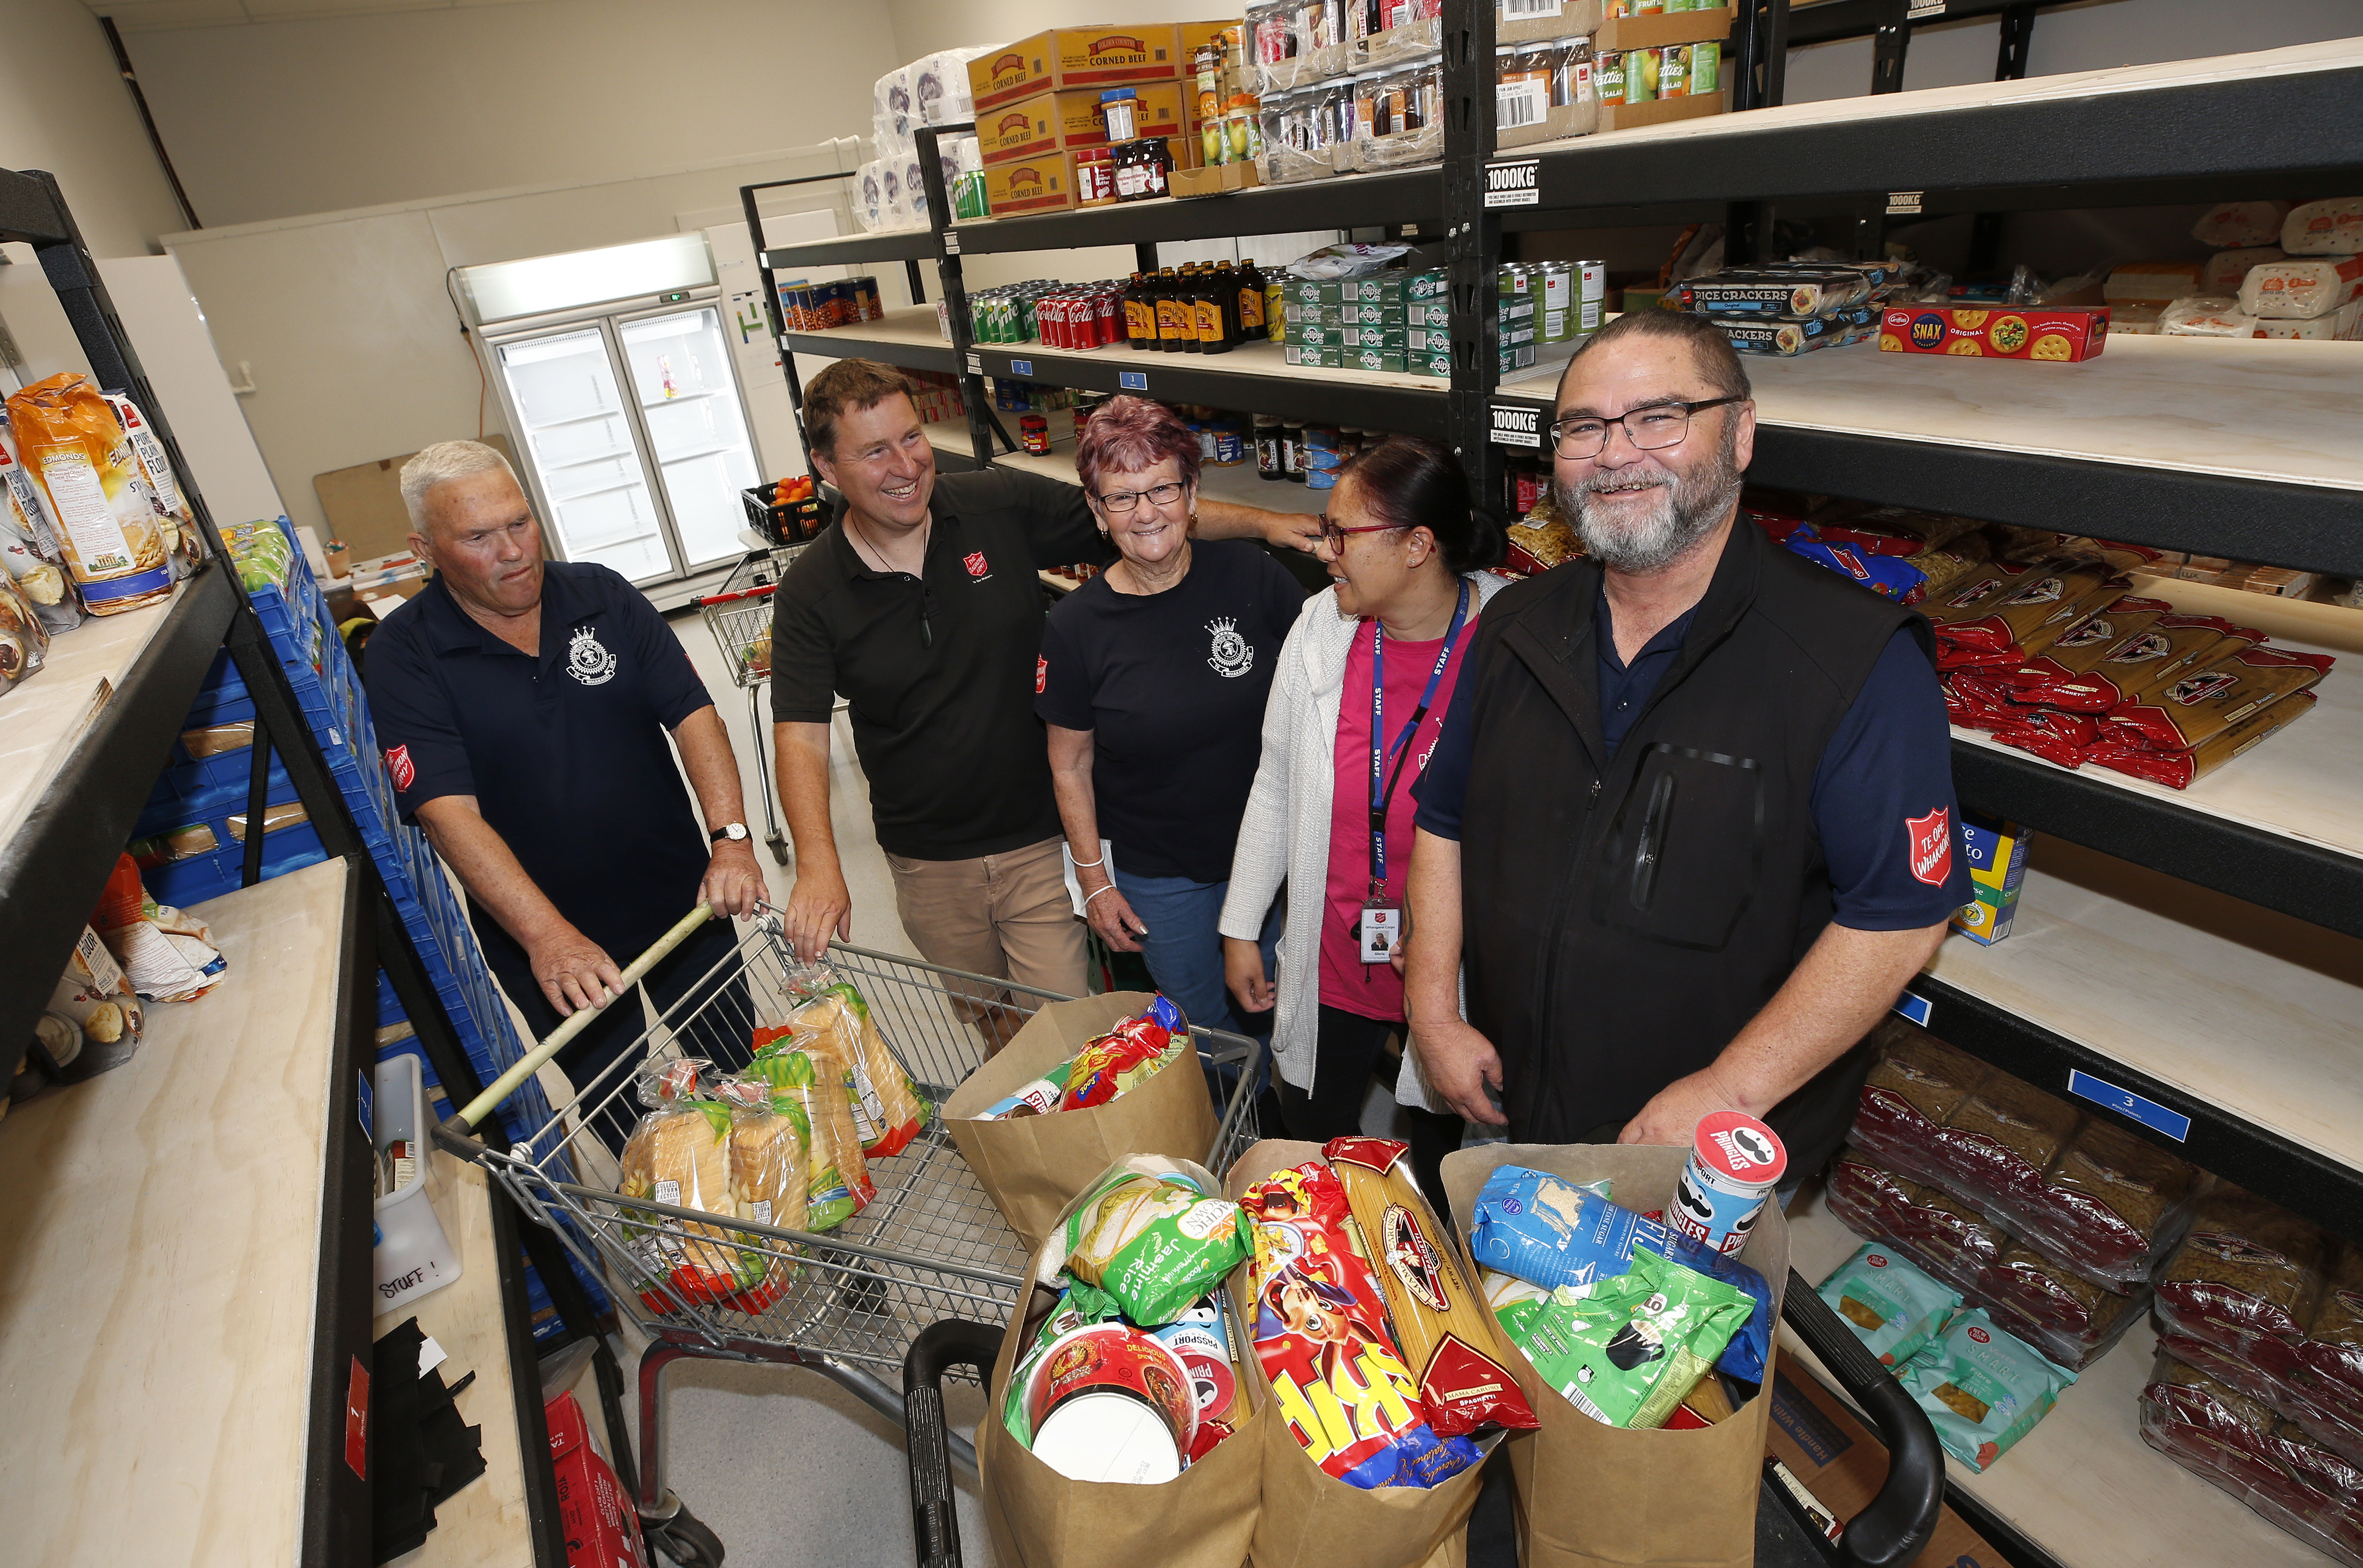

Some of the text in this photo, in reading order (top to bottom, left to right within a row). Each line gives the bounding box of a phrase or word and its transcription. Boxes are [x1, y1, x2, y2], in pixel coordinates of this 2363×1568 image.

[1638, 0, 1656, 8] FRUIT
[1090, 56, 1125, 66] CORNED
[1128, 53, 1147, 63] BEEF
[993, 71, 1026, 90] CORNED BEEF
[1661, 81, 1682, 90] SALAD
[1605, 89, 1623, 98] SALAD
[1000, 131, 1031, 147] CORNED BEEF
[1011, 187, 1043, 199] CORNED BEEF
[1299, 286, 1320, 299] eclipse
[1359, 284, 1382, 297] eclipse
[1409, 280, 1435, 296] eclipse
[1695, 291, 1788, 301] RICE CRACKERS
[1069, 300, 1094, 323] Cola
[1301, 308, 1322, 320] eclipse
[1359, 308, 1382, 322] eclipse
[1426, 309, 1449, 323] eclipse
[1889, 315, 1908, 324] Griffin's
[1302, 329, 1324, 343] eclipse
[1360, 329, 1384, 343] eclipse
[1912, 322, 1943, 340] SNAX
[1950, 327, 1984, 337] ORIGINAL
[2094, 322, 2106, 335] SNAX
[1301, 350, 1322, 363] eclipse
[1360, 353, 1382, 366] eclipse
[134, 431, 152, 447] PURE
[42, 453, 86, 465] EDMONDS
[140, 444, 160, 460] PLAIN
[1434, 646, 1451, 676] STAFF
[1226, 665, 1249, 676] WHAKAORA
[586, 674, 611, 684] WHAKAORA
[2053, 687, 2086, 698] SPAGHETTI
[2197, 683, 2222, 697] SPAGHETTI
[2255, 692, 2277, 705] SPAGHETTI
[2226, 703, 2258, 722] MAMA CARUSO
[1921, 818, 1945, 854] TE OPE
[1375, 836, 1384, 864] STAFF
[1969, 910, 1975, 918] 7
[1079, 1074, 1096, 1096] 300g
[2122, 1095, 2135, 1108] 3
[2112, 1102, 2142, 1119] Piro/Points
[1709, 1130, 1752, 1171] PRINGLES
[1949, 1155, 1977, 1173] ELBOWS
[1944, 1184, 1972, 1202] ELBOWS
[1594, 1209, 1613, 1245] CANE SUGAR
[1369, 1228, 1380, 1251] PRODUCT
[1663, 1232, 1678, 1262] SUGARS
[2216, 1235, 2249, 1246] ELBOWS
[1387, 1213, 1424, 1293] MAMA CARUSO
[1414, 1233, 1435, 1275] SPAGHETTI
[1872, 1255, 1885, 1263] NEW
[1131, 1238, 1181, 1301] Jasmine
[1869, 1258, 1886, 1267] LOOK!
[379, 1267, 424, 1299] STUFF
[1119, 1258, 1145, 1294] Rice
[1387, 1278, 1398, 1301] ENRICHED
[1452, 1279, 1461, 1290] NET
[1865, 1268, 1911, 1302] SMART
[1867, 1290, 1887, 1306] Fibre
[1226, 1315, 1234, 1340] CARUSO
[1973, 1329, 1987, 1338] NEW
[1173, 1336, 1218, 1350] PASSPORT
[1969, 1332, 1988, 1344] LOOK!
[1126, 1344, 1166, 1361] DELICIOUS
[1966, 1345, 2021, 1386] SMART
[1969, 1367, 1992, 1385] Fibre
[1448, 1384, 1500, 1400] MAMA CARUSO
[1960, 1382, 1982, 1398] PENNE
[1459, 1394, 1497, 1407] SPAGHETTI
[1773, 1404, 1828, 1461] Handle With
